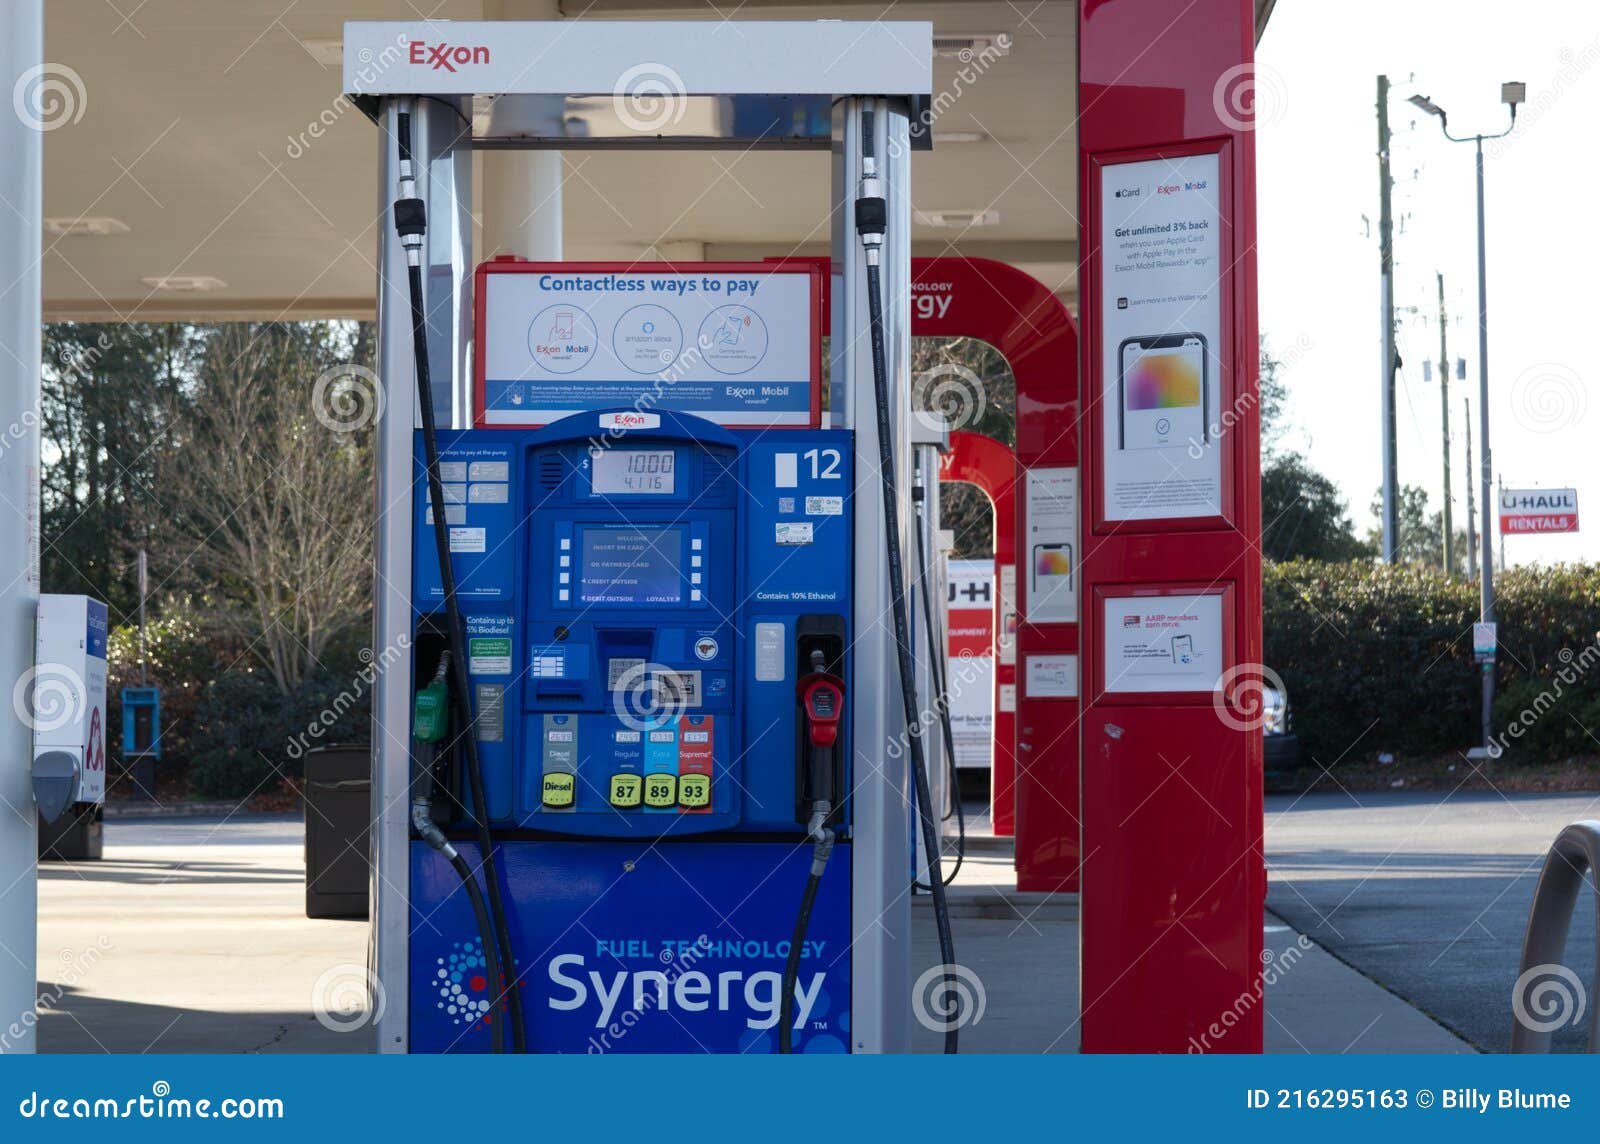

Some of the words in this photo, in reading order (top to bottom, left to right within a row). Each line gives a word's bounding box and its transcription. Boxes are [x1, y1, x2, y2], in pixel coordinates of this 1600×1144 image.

[409, 41, 490, 72] Exxon
[1122, 189, 1140, 198] Card
[1157, 185, 1180, 195] Exxon
[1185, 181, 1207, 190] Mobil
[1115, 228, 1130, 237] Get
[1132, 225, 1171, 236] unlimited
[1173, 223, 1187, 232] 3%
[1189, 220, 1208, 230] back
[539, 274, 645, 292] Contactless
[651, 279, 697, 297] ways
[702, 277, 721, 292] to
[726, 279, 760, 297] pay
[536, 345, 561, 355] Exxon
[566, 345, 589, 354] Mobil
[726, 386, 755, 399] Exxon
[761, 386, 789, 396] Mobil
[614, 414, 645, 426] Exxon
[803, 448, 841, 479] 12
[1502, 495, 1573, 509] U-HAUL
[1508, 517, 1568, 530] RENTALS
[757, 592, 789, 600] Contains
[790, 592, 806, 600] 10%
[807, 592, 836, 600] Ethanol
[466, 616, 495, 625] Contains
[497, 618, 505, 626] up
[506, 616, 514, 625] to
[478, 625, 509, 634] Biodiesel
[614, 751, 640, 759] Regular
[545, 782, 572, 791] Diesel
[616, 786, 635, 798] 87
[650, 786, 669, 798] 89
[684, 786, 703, 798] 93
[596, 940, 655, 958] FUEL
[661, 940, 827, 958] TECHNOLOGY
[548, 953, 827, 1030] Synergy
